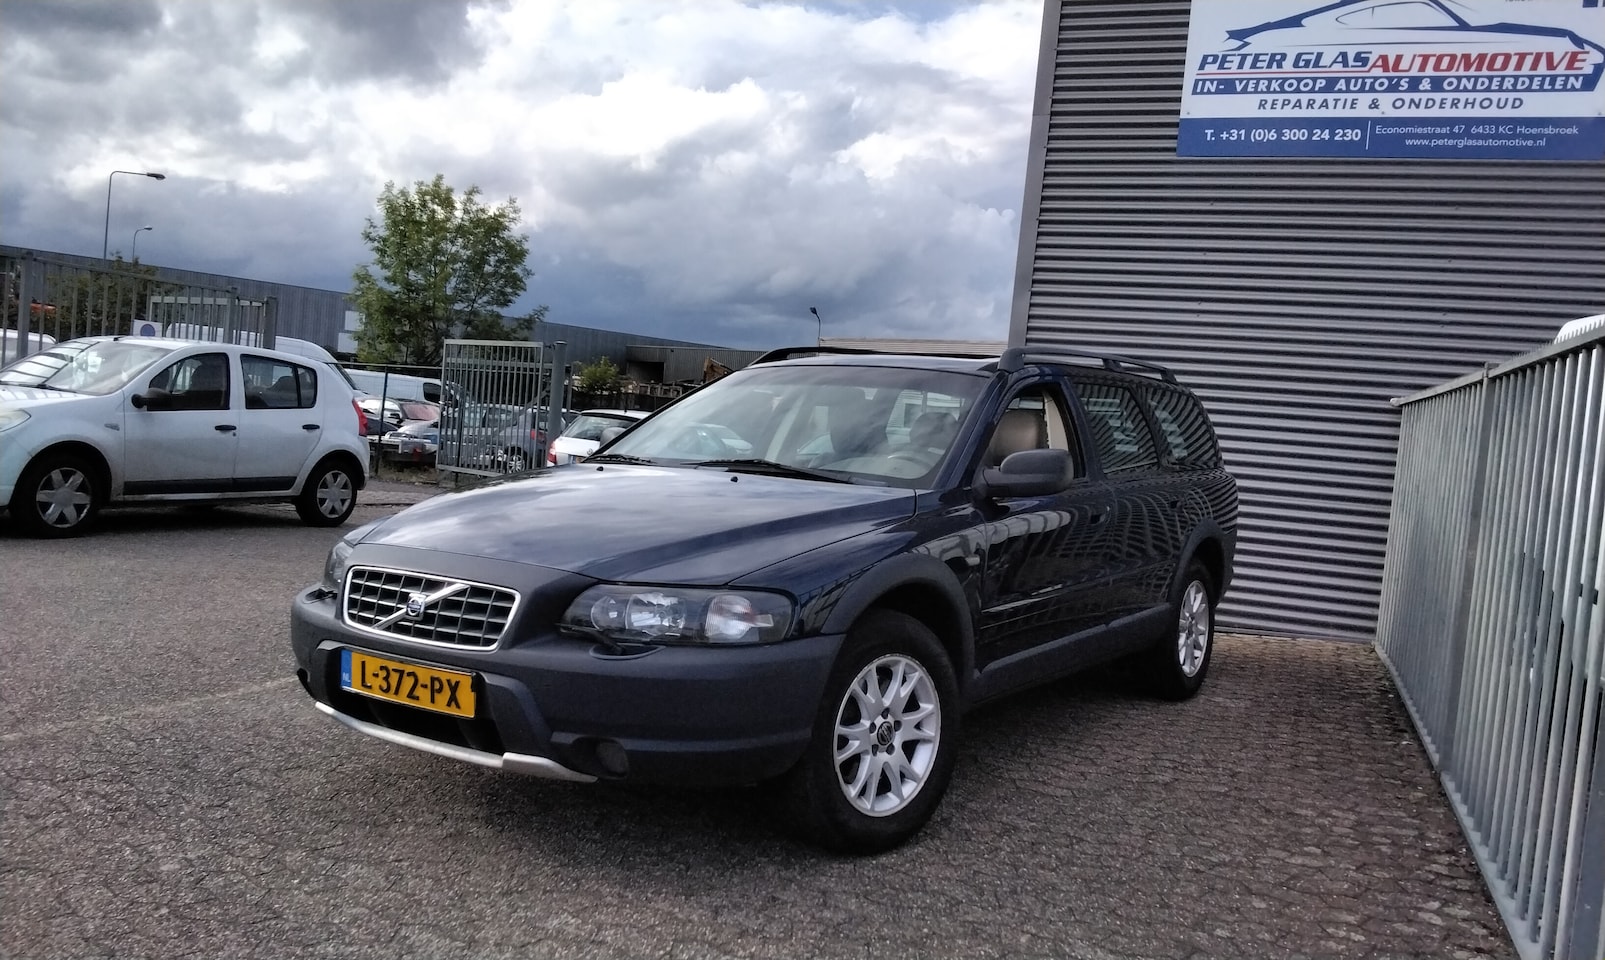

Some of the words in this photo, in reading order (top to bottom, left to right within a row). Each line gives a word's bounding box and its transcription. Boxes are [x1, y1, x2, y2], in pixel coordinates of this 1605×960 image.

[1198, 52, 1286, 70] PETER
[1292, 51, 1372, 69] GLAS
[1370, 51, 1590, 73] AUTOMOTIVE
[1196, 80, 1225, 93] IN-
[1235, 79, 1326, 92] VERKOOP
[1418, 79, 1432, 90] &
[1443, 76, 1584, 90] ONDERDELEN
[1257, 98, 1359, 110] REPARATIE
[1368, 98, 1380, 110] &
[1391, 97, 1524, 110] ONDERHOUD
[1205, 129, 1215, 141] T.
[1220, 129, 1246, 141] +31
[1250, 128, 1277, 142] (0)6
[1281, 129, 1308, 141] 300
[1312, 129, 1330, 141] 24
[1334, 129, 1361, 141] 230
[1375, 125, 1450, 134] Economiestraat
[1452, 125, 1465, 134] 47
[1470, 125, 1496, 134] 6433
[1498, 125, 1514, 134] KC
[1516, 125, 1579, 135] Hoensbroek
[1405, 137, 1546, 147] www.peterglasautomotive.nl
[361, 661, 461, 709] L-372-PX
